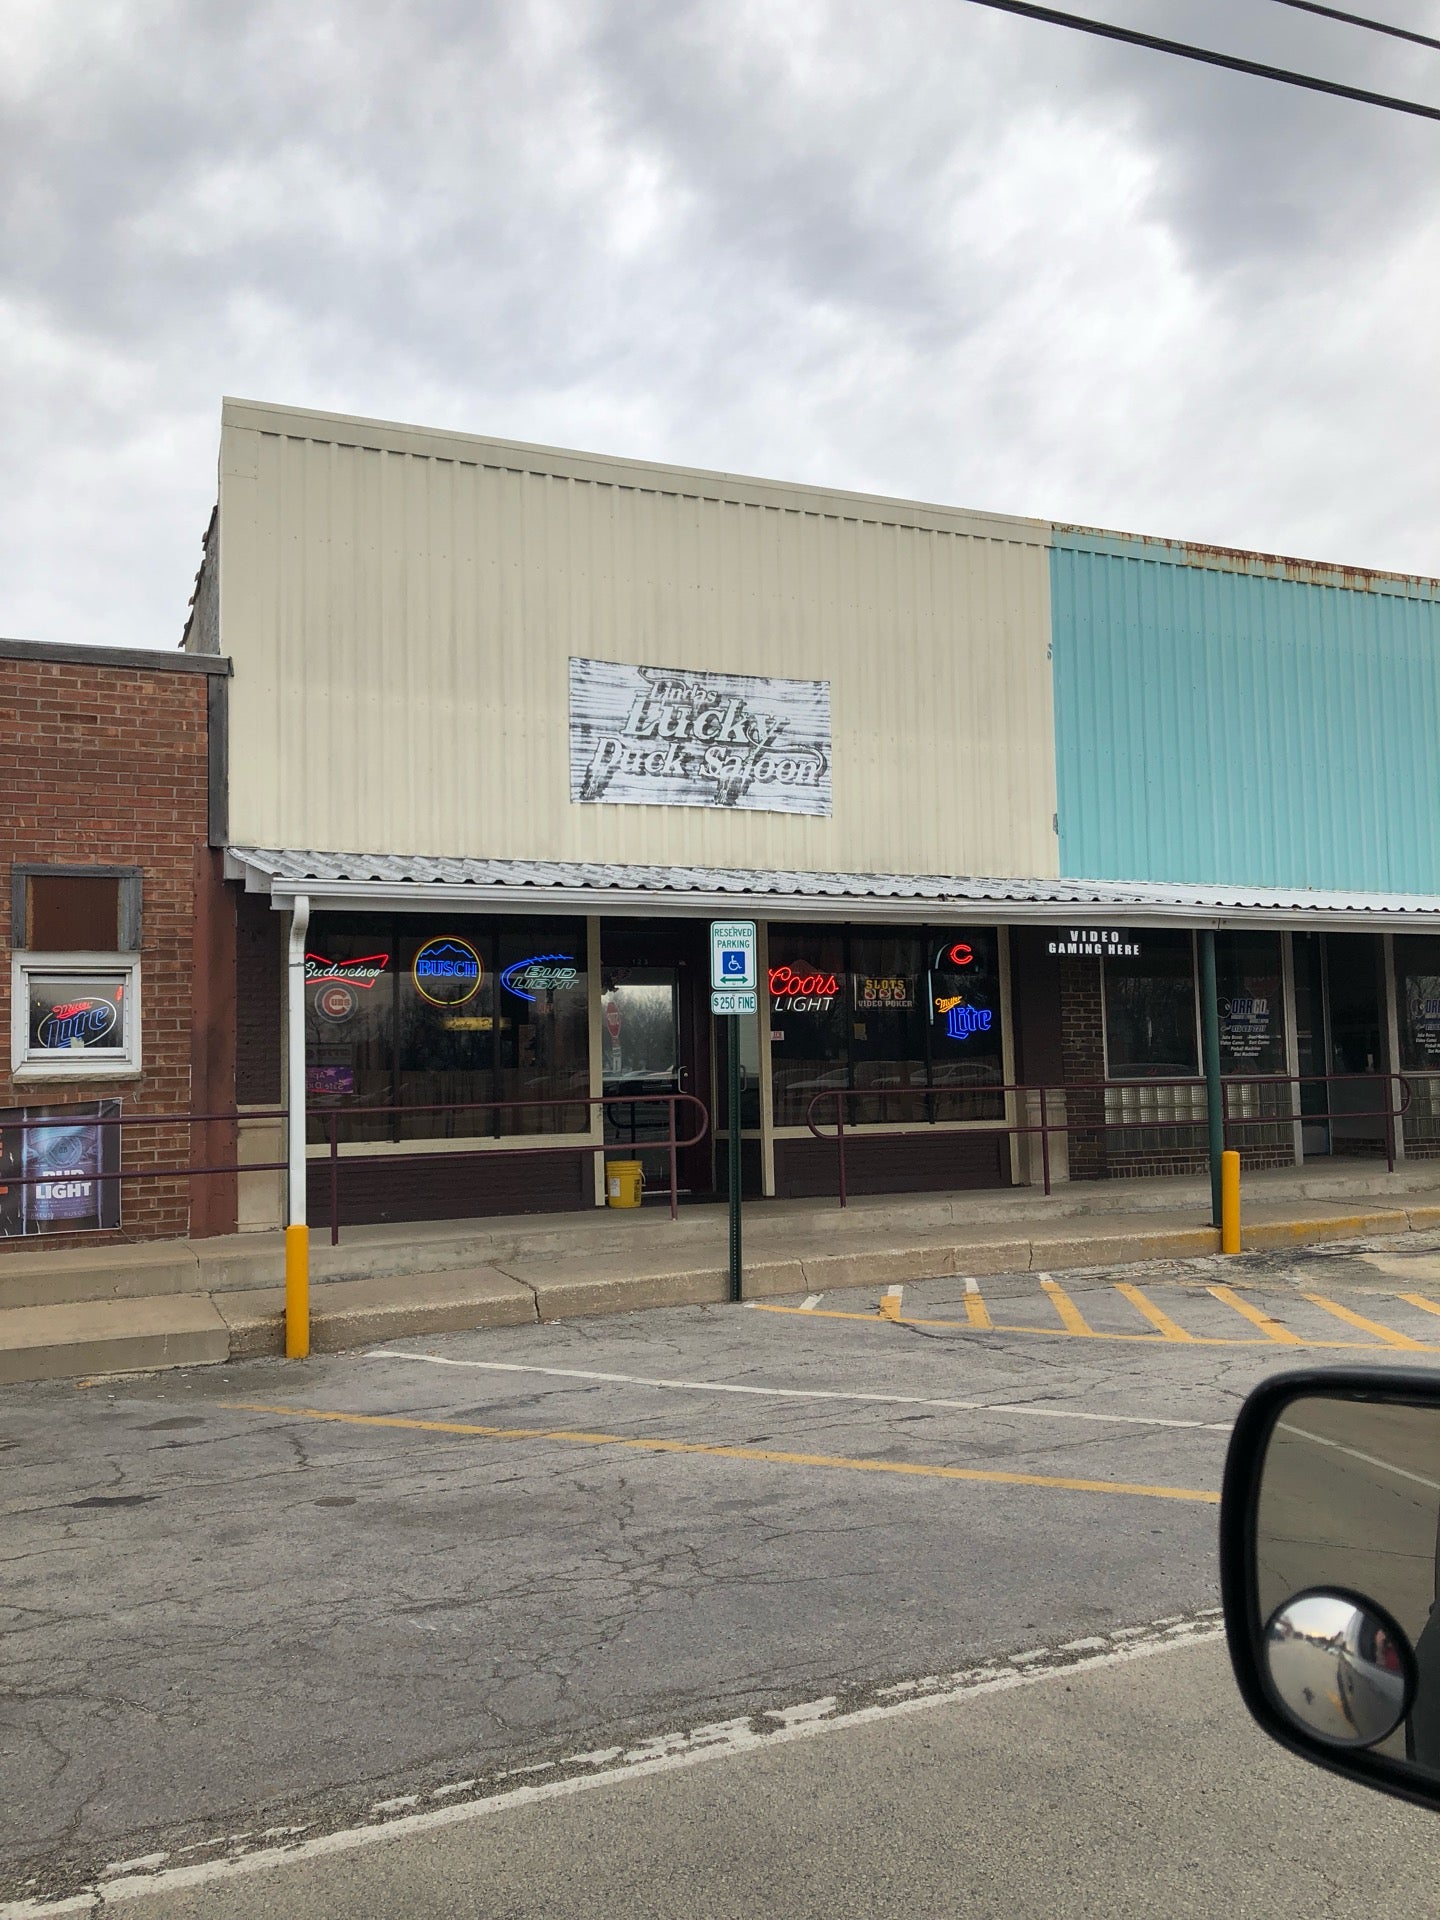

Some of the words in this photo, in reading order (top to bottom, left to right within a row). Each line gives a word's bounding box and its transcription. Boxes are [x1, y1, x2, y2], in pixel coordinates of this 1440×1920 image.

[620, 697, 788, 748] Lucky
[590, 736, 690, 777] Duck
[699, 744, 823, 785] Saloon
[714, 928, 752, 938] RESERVED
[1070, 930, 1119, 943] VIDEO
[717, 939, 750, 949] PARKING
[1048, 942, 1102, 955] GAMING
[1107, 943, 1140, 956] HERE
[305, 961, 384, 978] Budweiser
[417, 959, 478, 978] BUSCH
[524, 965, 577, 979] BUD
[511, 976, 580, 990] LIGHT
[768, 966, 839, 995] Coors
[865, 979, 905, 990] SLOTS
[738, 996, 755, 1009] FINE
[774, 996, 834, 1012] LIGHT
[947, 1003, 992, 1040] Lite
[35, 1182, 92, 1200] LIGHT
